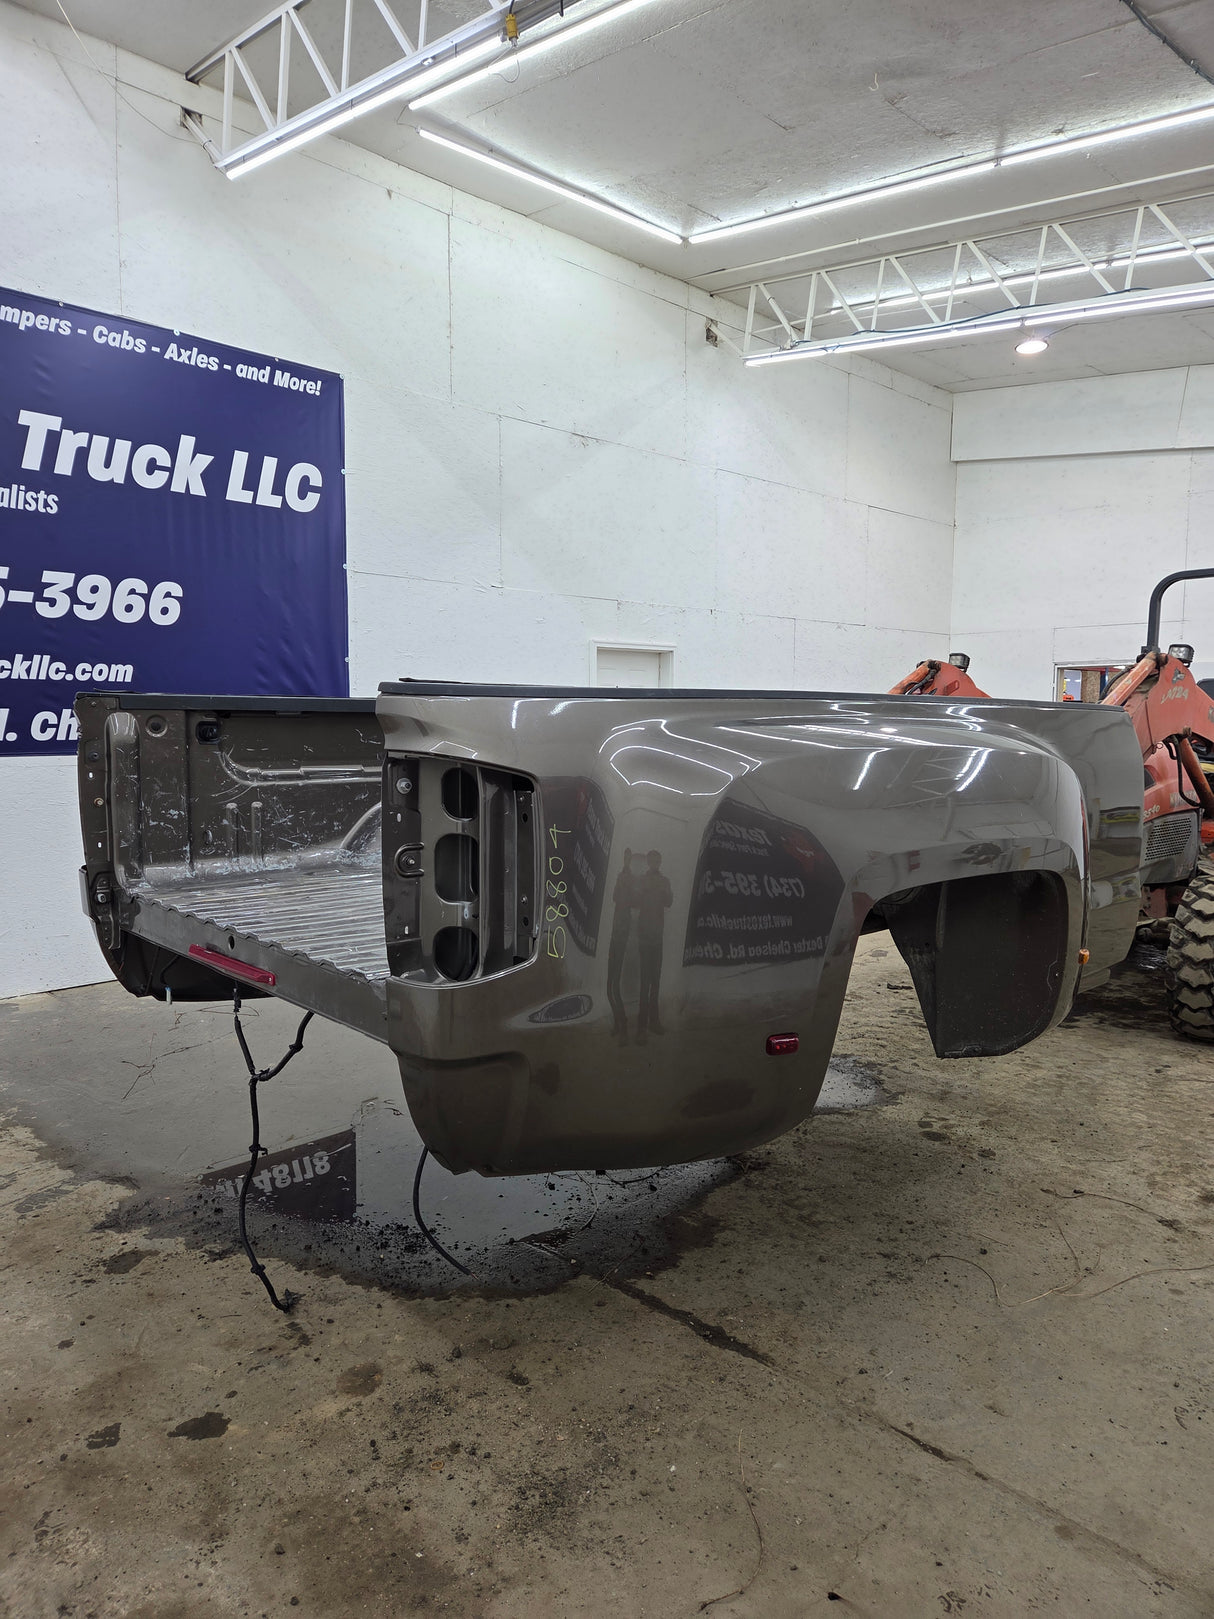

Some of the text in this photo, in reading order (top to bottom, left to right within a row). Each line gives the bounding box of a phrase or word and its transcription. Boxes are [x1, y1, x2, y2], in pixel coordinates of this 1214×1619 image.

[93, 325, 147, 353] Cabs
[164, 342, 220, 371] Axles
[236, 363, 271, 384] and
[273, 369, 322, 396] More!
[17, 409, 323, 512] Truck LLC
[545, 823, 571, 959] 58804
